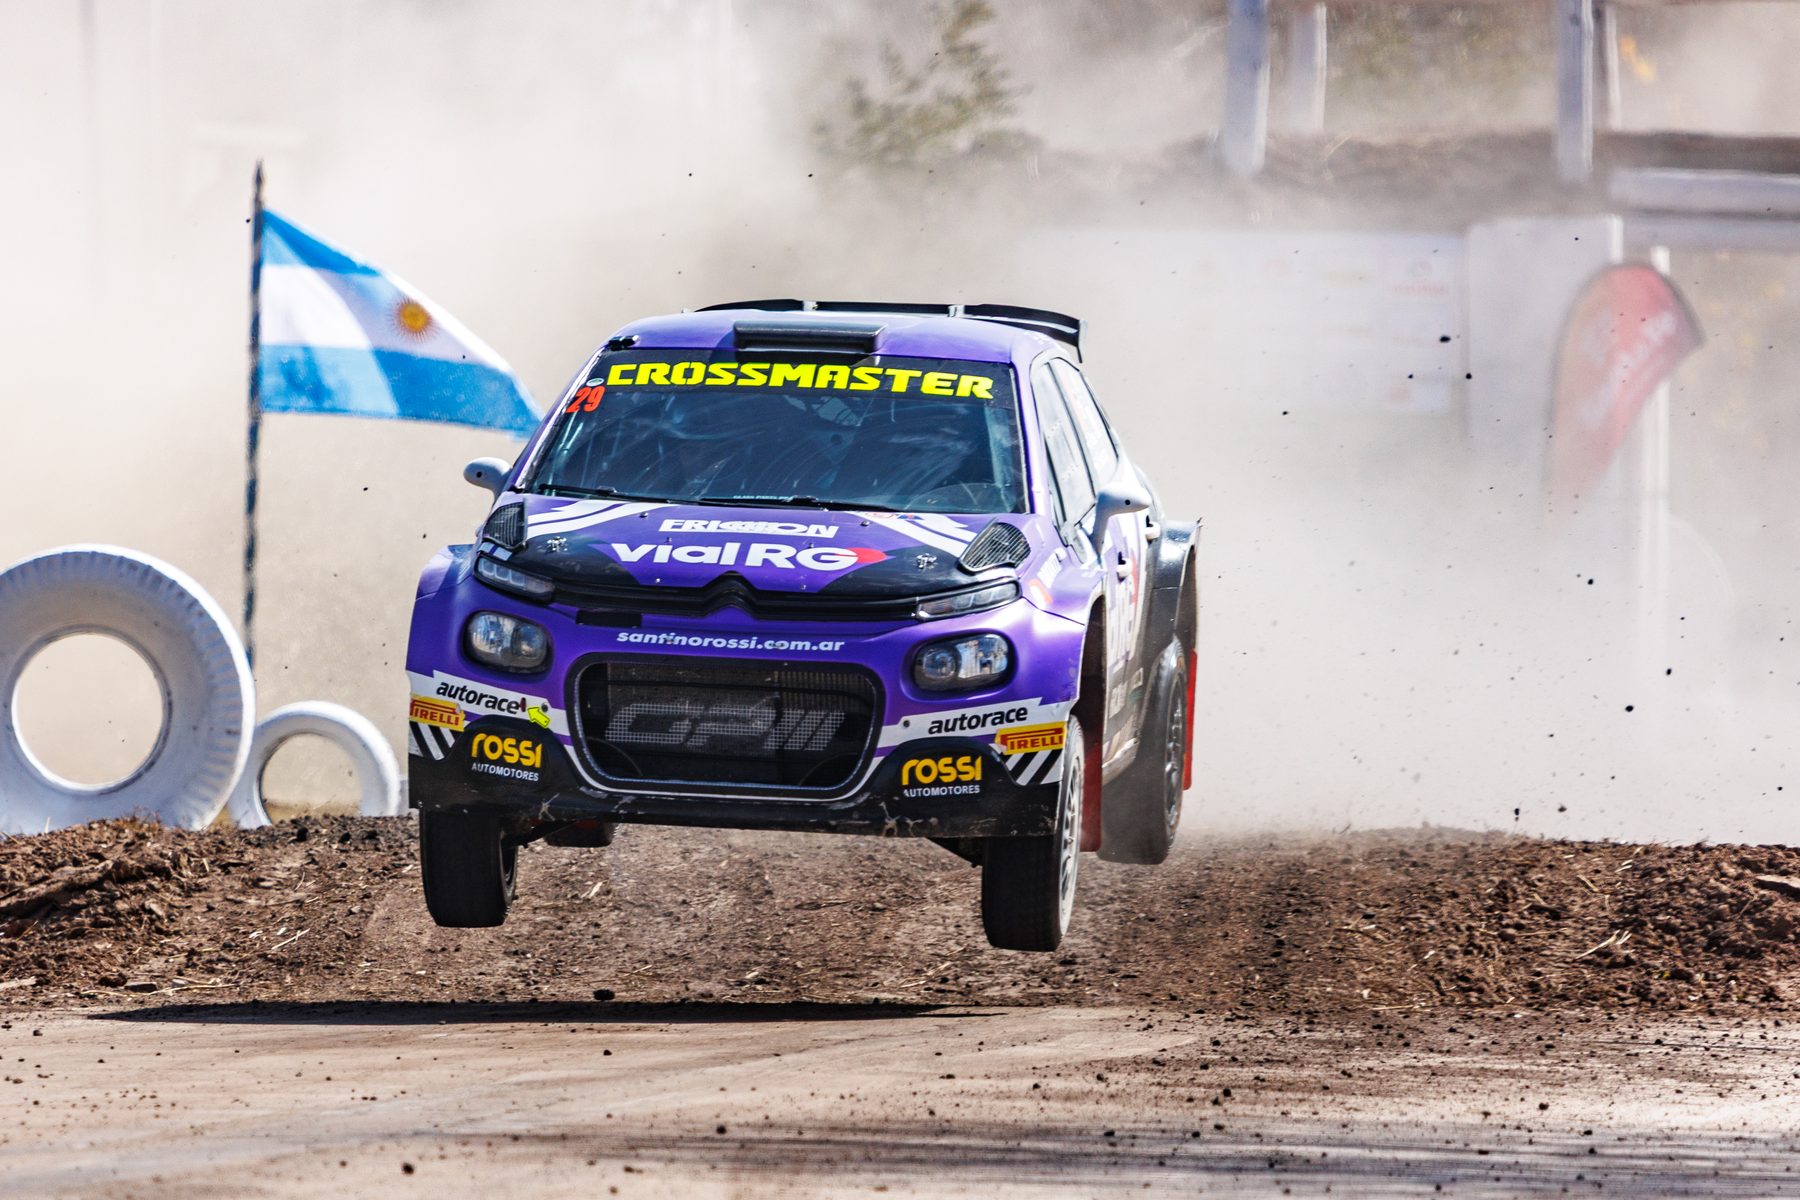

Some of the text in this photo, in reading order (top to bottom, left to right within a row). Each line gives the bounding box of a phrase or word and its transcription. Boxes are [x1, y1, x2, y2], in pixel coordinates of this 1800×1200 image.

[607, 362, 993, 398] CROSSMASTER
[565, 385, 606, 413] 29
[616, 631, 845, 651] santinorossi.com.ar
[436, 682, 520, 714] autorace
[928, 707, 1028, 735] autorace
[1000, 728, 1064, 750] PIRELLI
[471, 762, 540, 782] AUTOMOTORES
[903, 785, 980, 798] AUTOMOTORES
